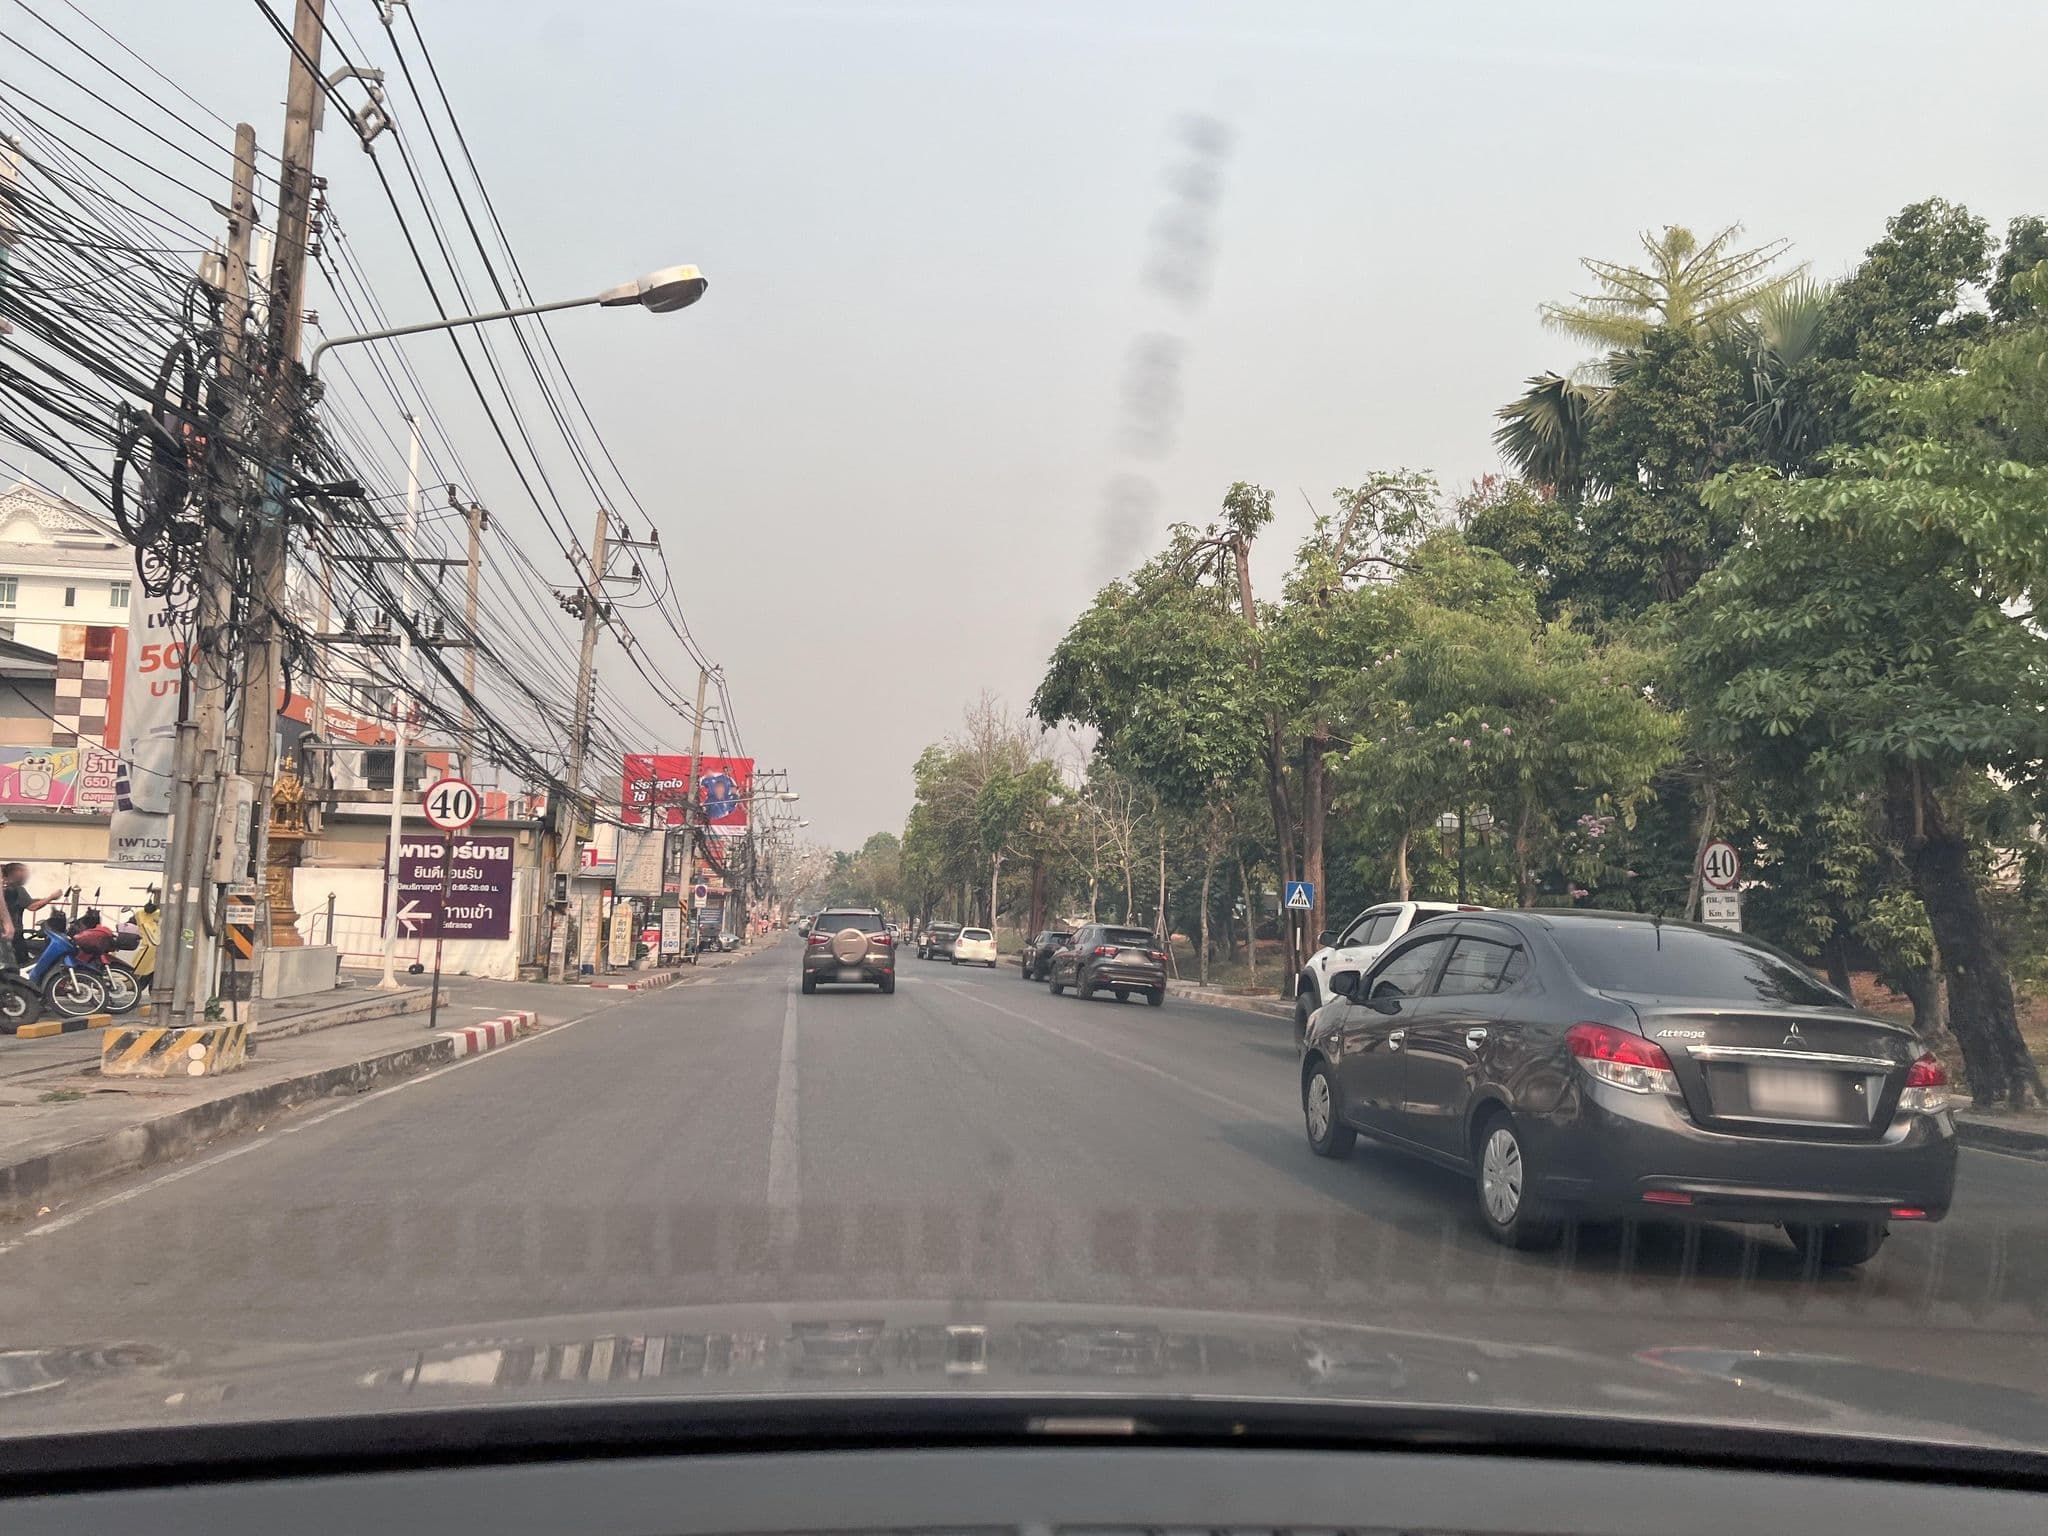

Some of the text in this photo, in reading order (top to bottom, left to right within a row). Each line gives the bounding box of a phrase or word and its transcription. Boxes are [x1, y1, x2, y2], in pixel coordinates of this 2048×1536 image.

[84, 775, 110, 788] 650
[430, 789, 473, 820] 40
[1706, 850, 1734, 878] 40
[1656, 1029, 1706, 1039] Attrage
